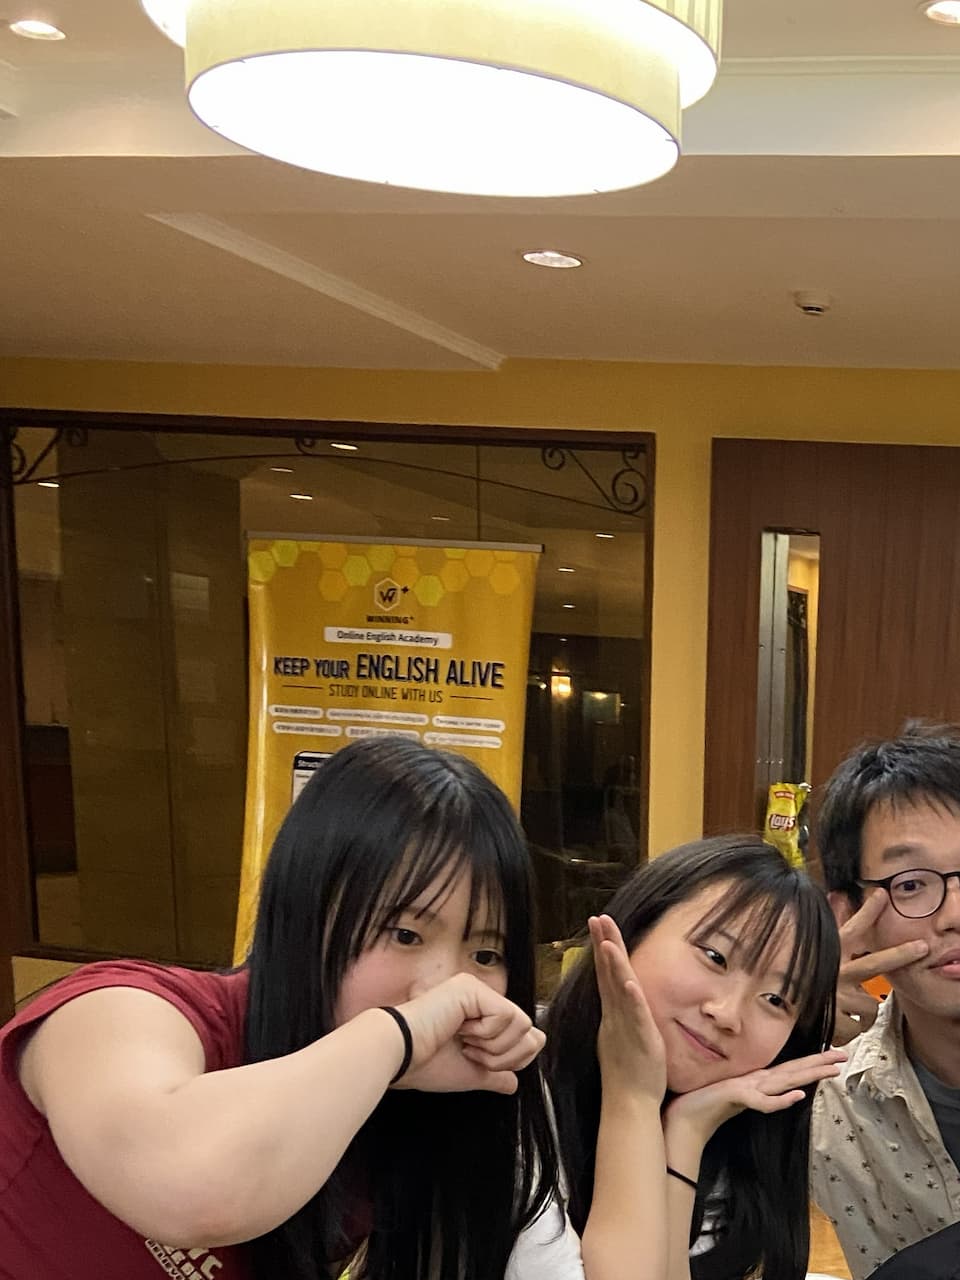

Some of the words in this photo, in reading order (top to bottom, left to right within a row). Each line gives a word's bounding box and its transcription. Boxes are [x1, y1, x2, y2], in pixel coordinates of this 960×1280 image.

[337, 630, 364, 641] Online
[366, 631, 396, 643] English
[398, 633, 439, 646] Academy
[274, 656, 310, 677] KEEP
[315, 659, 350, 679] YOUR
[356, 653, 440, 684] ENGLISH
[446, 658, 506, 688] ALIVE
[329, 684, 359, 697] STUDY
[361, 685, 397, 700] ONLINE
[401, 688, 427, 701] WITH
[429, 690, 444, 703] US
